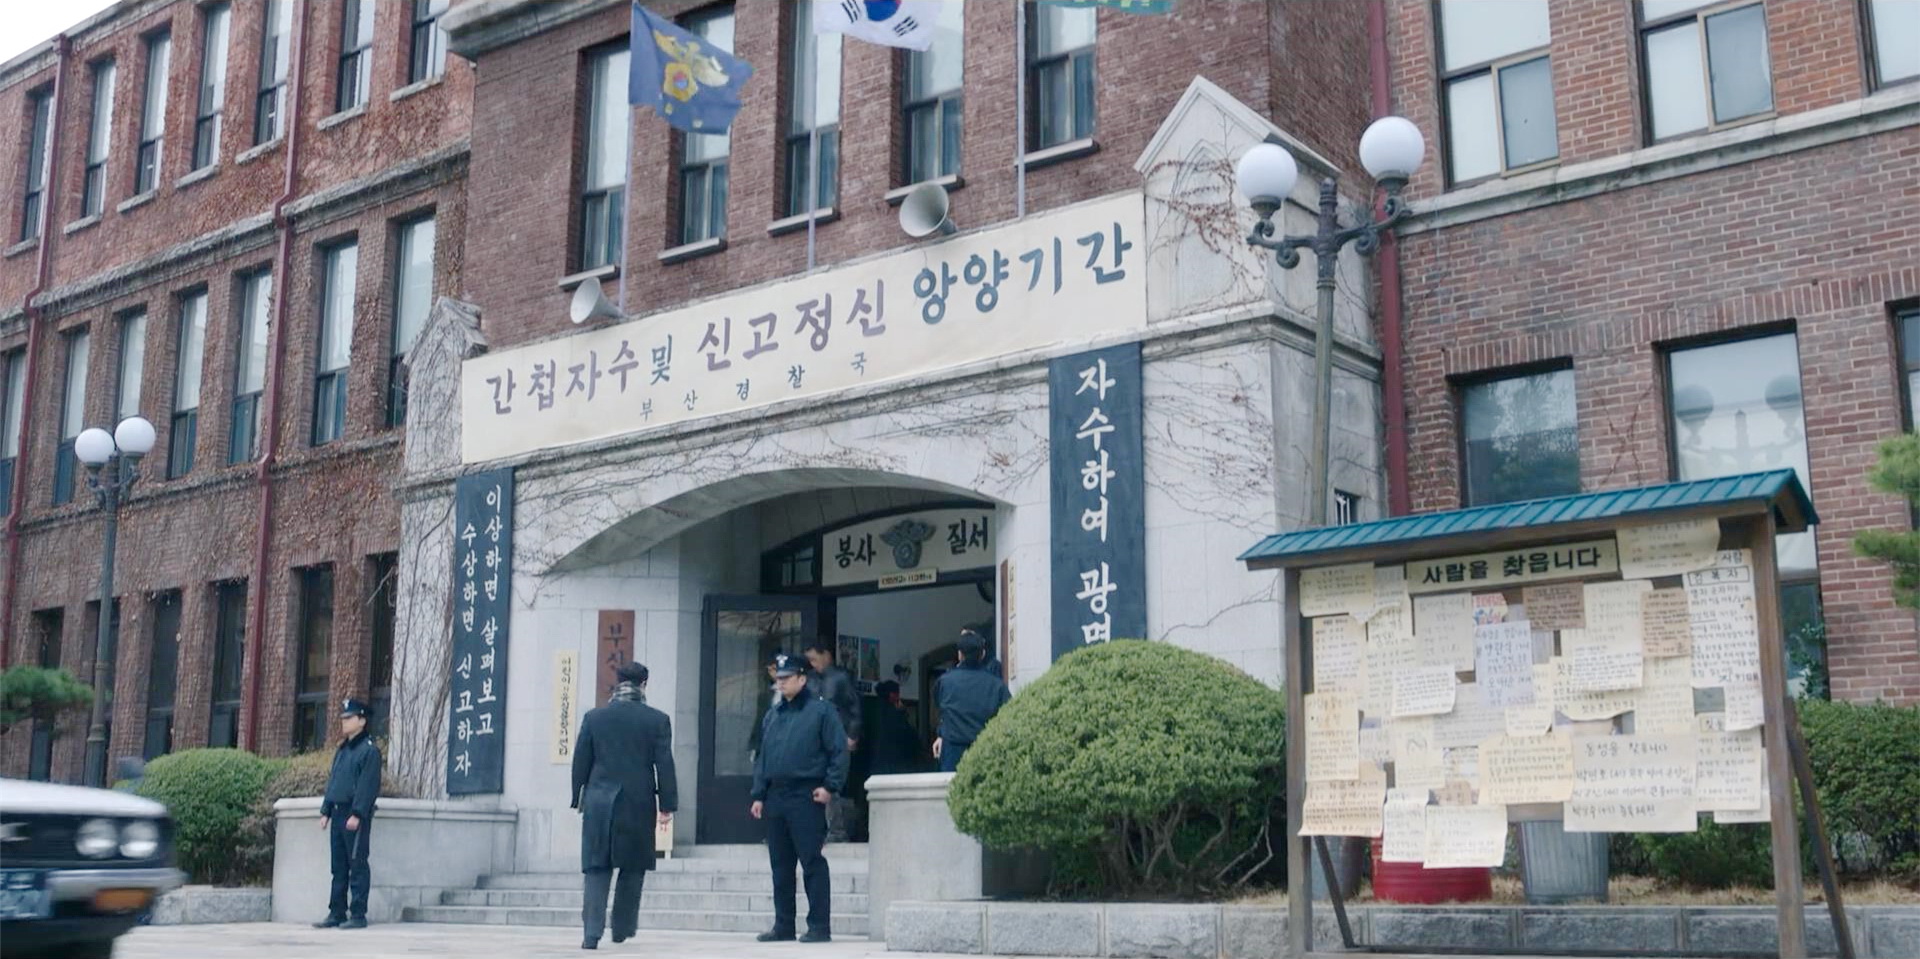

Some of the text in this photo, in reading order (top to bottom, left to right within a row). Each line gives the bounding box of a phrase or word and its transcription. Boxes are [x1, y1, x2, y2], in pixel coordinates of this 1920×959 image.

[486, 221, 1133, 415] 간첩자수 및 신고정신 앙양기간
[835, 515, 989, 569] 봉사 질서
[1075, 358, 1117, 543] 자수하여
[454, 522, 478, 778] 수상하면 신고하자
[476, 484, 503, 737] 이상하면 살펴보고
[1422, 547, 1602, 584] 사람을 찾읍니다
